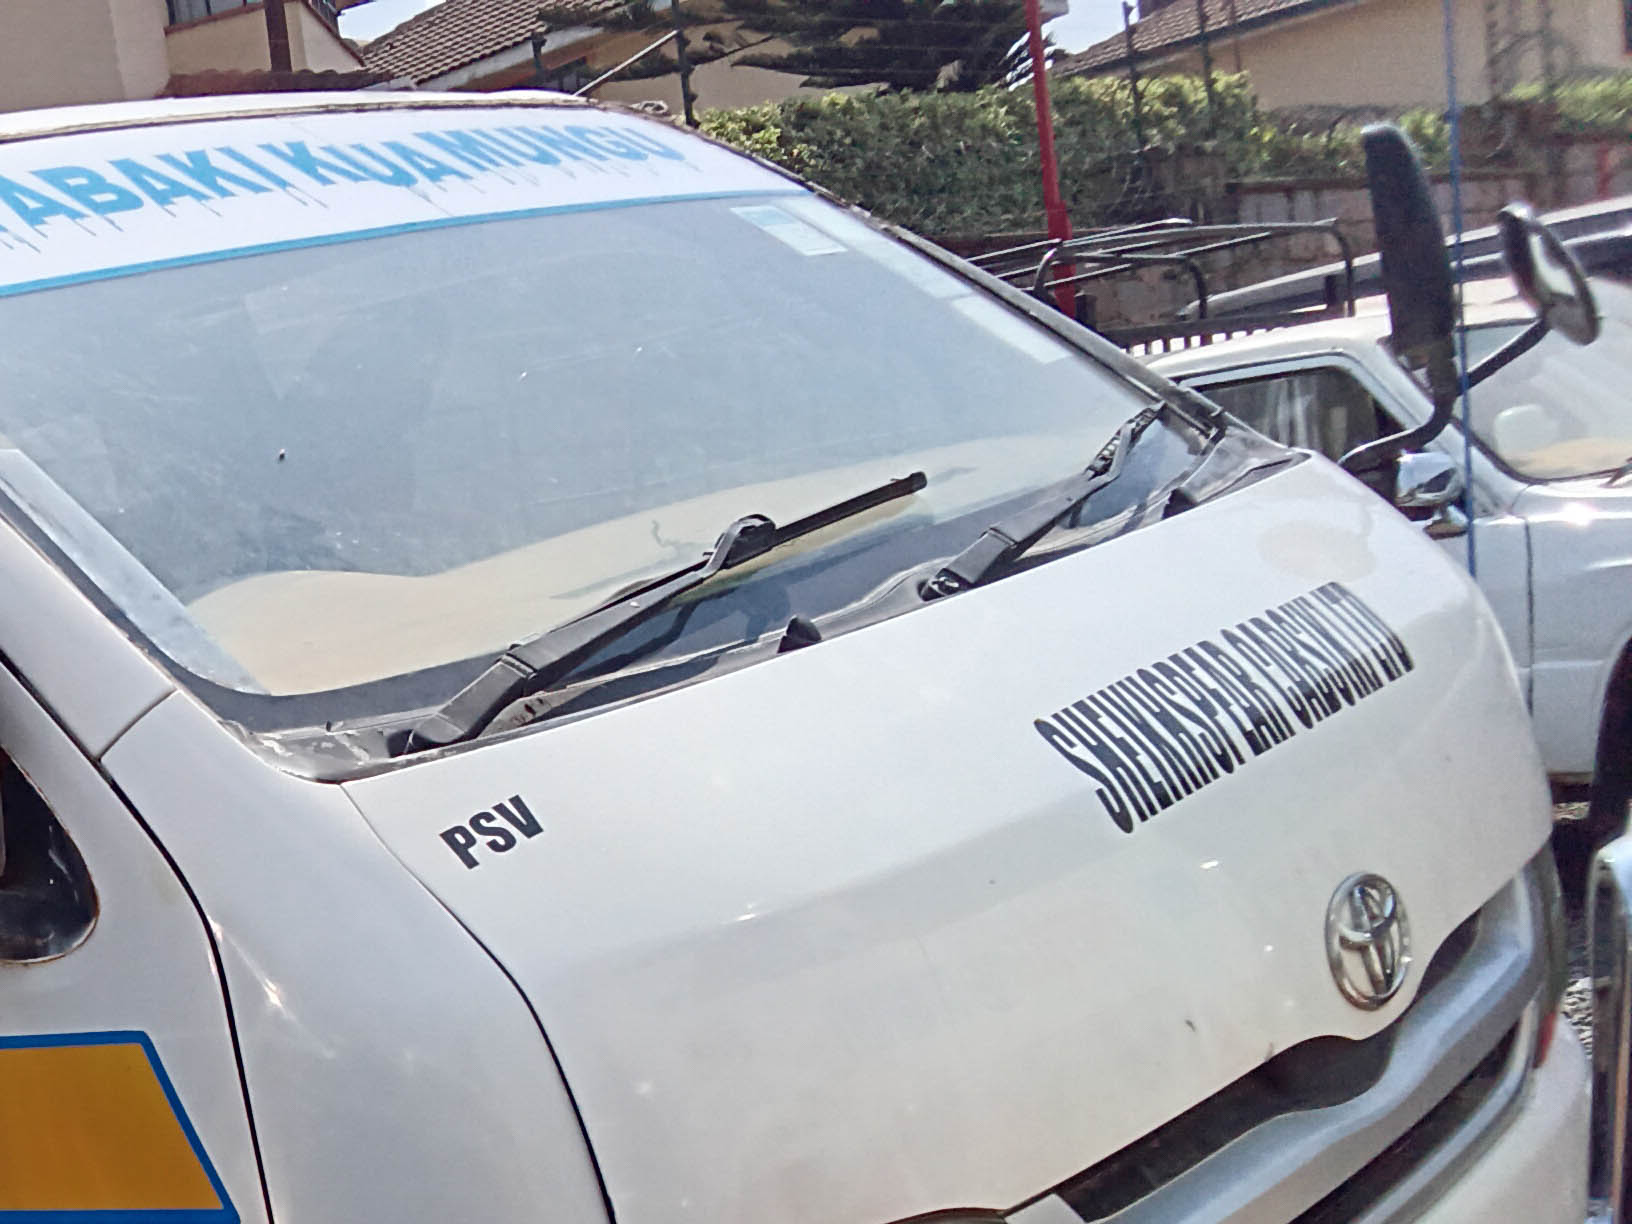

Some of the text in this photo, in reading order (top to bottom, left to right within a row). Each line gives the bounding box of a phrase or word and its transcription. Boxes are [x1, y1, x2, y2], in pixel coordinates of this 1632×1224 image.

[256, 140, 476, 187] KUA
[413, 125, 686, 172] MUNGU
[1032, 639, 1297, 835] SHEIKHSPEAR
[438, 793, 545, 870] PSV
